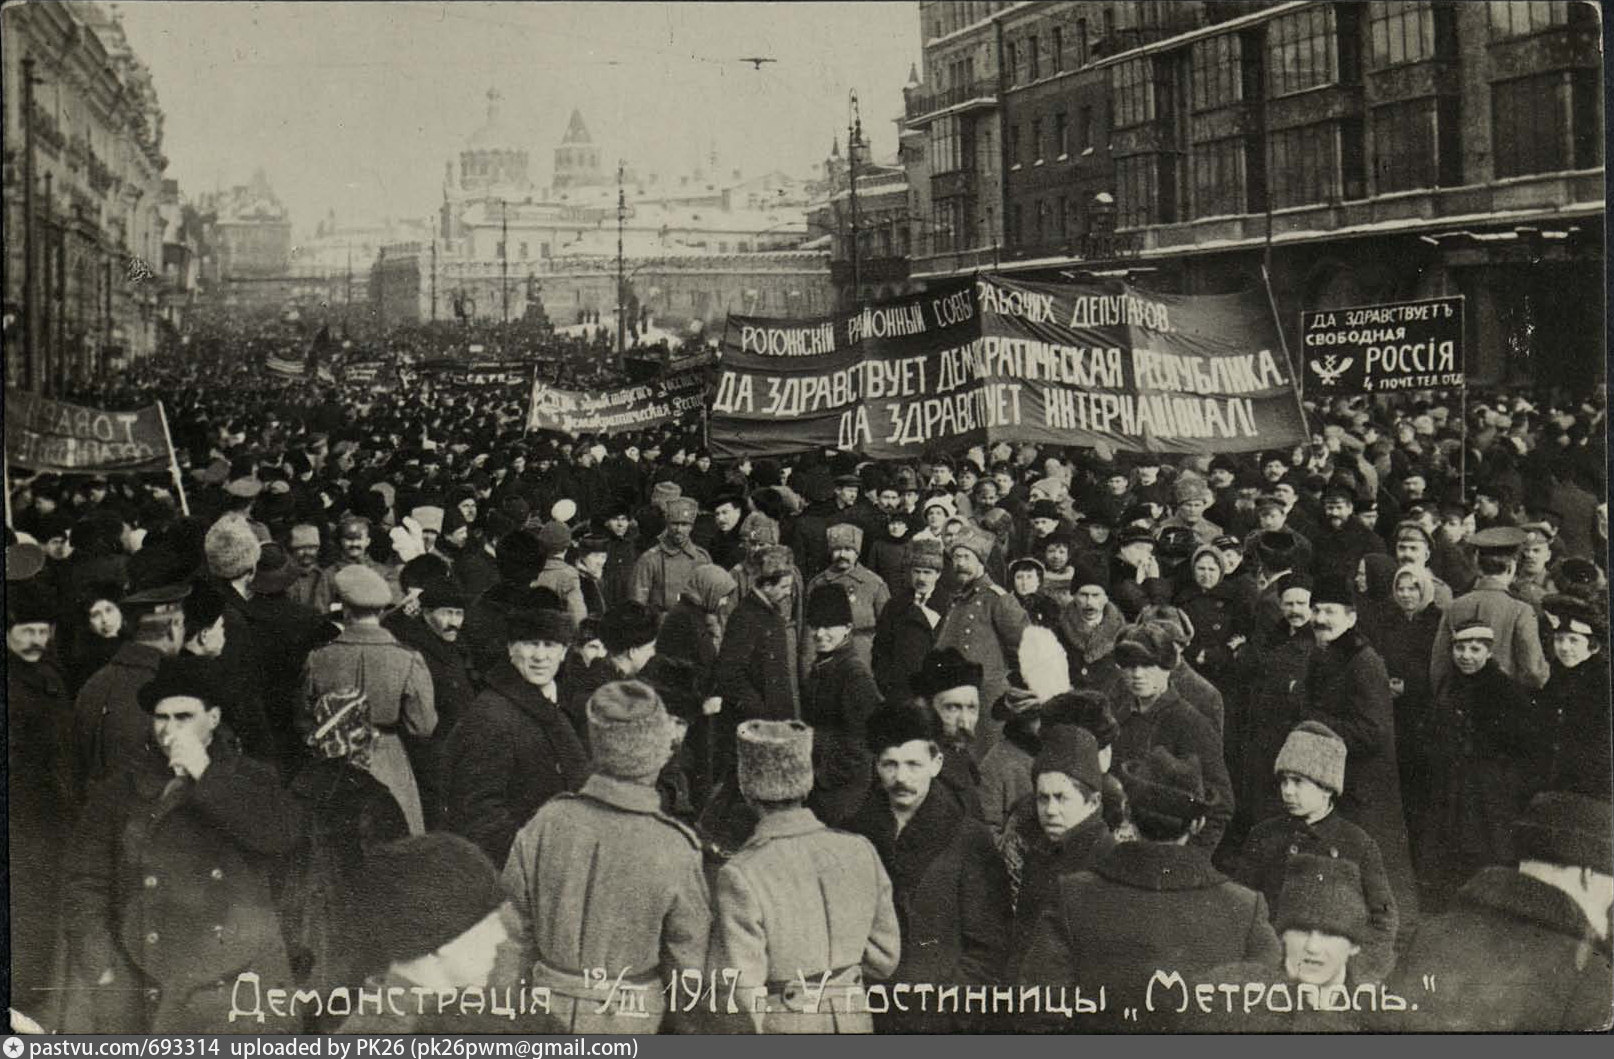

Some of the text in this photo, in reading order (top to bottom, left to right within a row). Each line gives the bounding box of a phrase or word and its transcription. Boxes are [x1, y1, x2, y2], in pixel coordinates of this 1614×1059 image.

[741, 322, 836, 356] РОГОЖСКІЙ
[848, 302, 926, 344] РАЙОННЫЙ
[975, 281, 1058, 324] РАБОЧИХ
[1310, 304, 1453, 329] ДА ЗДРАВСТВУЕТЪ
[1305, 327, 1406, 346] СВОБОДНАЯ
[1365, 337, 1454, 373] РОССІЯ
[712, 371, 754, 413] ДА
[762, 356, 928, 416] ЗДРАВСТВУЕТ
[1363, 376, 1373, 390] 4
[838, 406, 873, 450] ДА
